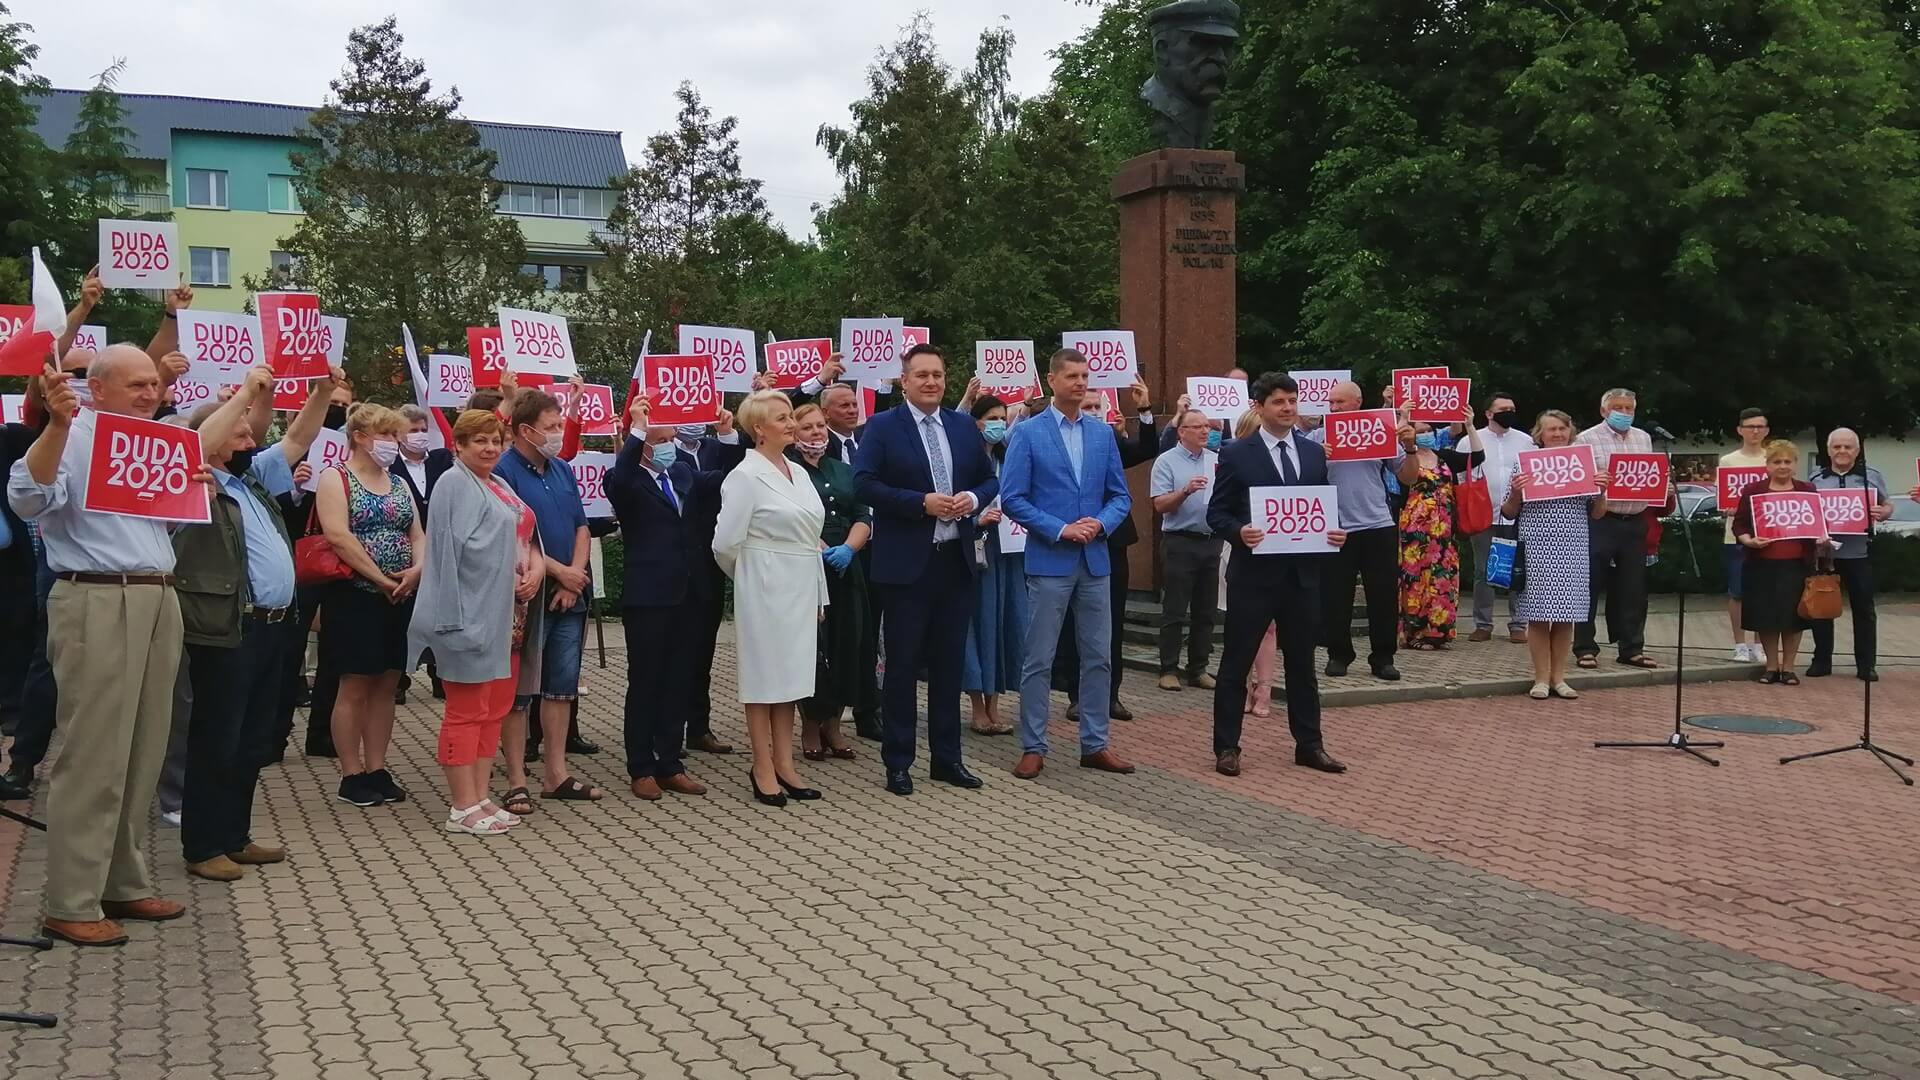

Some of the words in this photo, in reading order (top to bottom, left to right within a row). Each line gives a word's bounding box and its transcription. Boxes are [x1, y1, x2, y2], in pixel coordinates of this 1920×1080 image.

[112, 232, 167, 252] DUDA
[112, 251, 169, 270] 2020
[277, 307, 321, 332] DUD
[194, 323, 252, 345] DUDA
[511, 319, 562, 342] DUDA
[853, 329, 893, 346] DUDA
[75, 333, 97, 346] DA
[693, 337, 745, 357] DUDA
[197, 343, 254, 364] 2020
[515, 338, 565, 359] 2020
[776, 348, 822, 362] DUDA
[852, 345, 893, 362] 2020
[985, 349, 1025, 361] DUDA
[1076, 341, 1125, 356] DUDA
[713, 356, 746, 375] 20
[778, 360, 823, 376] 2020
[986, 361, 1026, 374] 2020
[1088, 356, 1127, 371] 020
[658, 366, 711, 387] DUDA
[174, 385, 209, 405] 020
[274, 379, 298, 395] 20
[659, 384, 712, 406] 2020
[1198, 384, 1238, 396] DUDA
[1419, 385, 1459, 398] DUDA
[1200, 396, 1240, 407] 2020
[1300, 391, 1330, 402] 202
[1418, 397, 1459, 410] 2020
[1335, 417, 1386, 435] DUDA
[1336, 431, 1386, 448] 2020
[110, 432, 188, 469] DUDA
[324, 440, 350, 462] DU
[1530, 454, 1583, 473] DUDA
[1616, 461, 1660, 474] DUDA
[107, 458, 188, 494] 2020
[1532, 467, 1585, 486] 2020
[1614, 473, 1660, 487] 2020
[1265, 497, 1325, 516] DUDA
[1763, 499, 1813, 515] DUDA
[1825, 508, 1865, 521] 020
[1266, 515, 1326, 534] 2020
[1765, 512, 1815, 528] 2020
